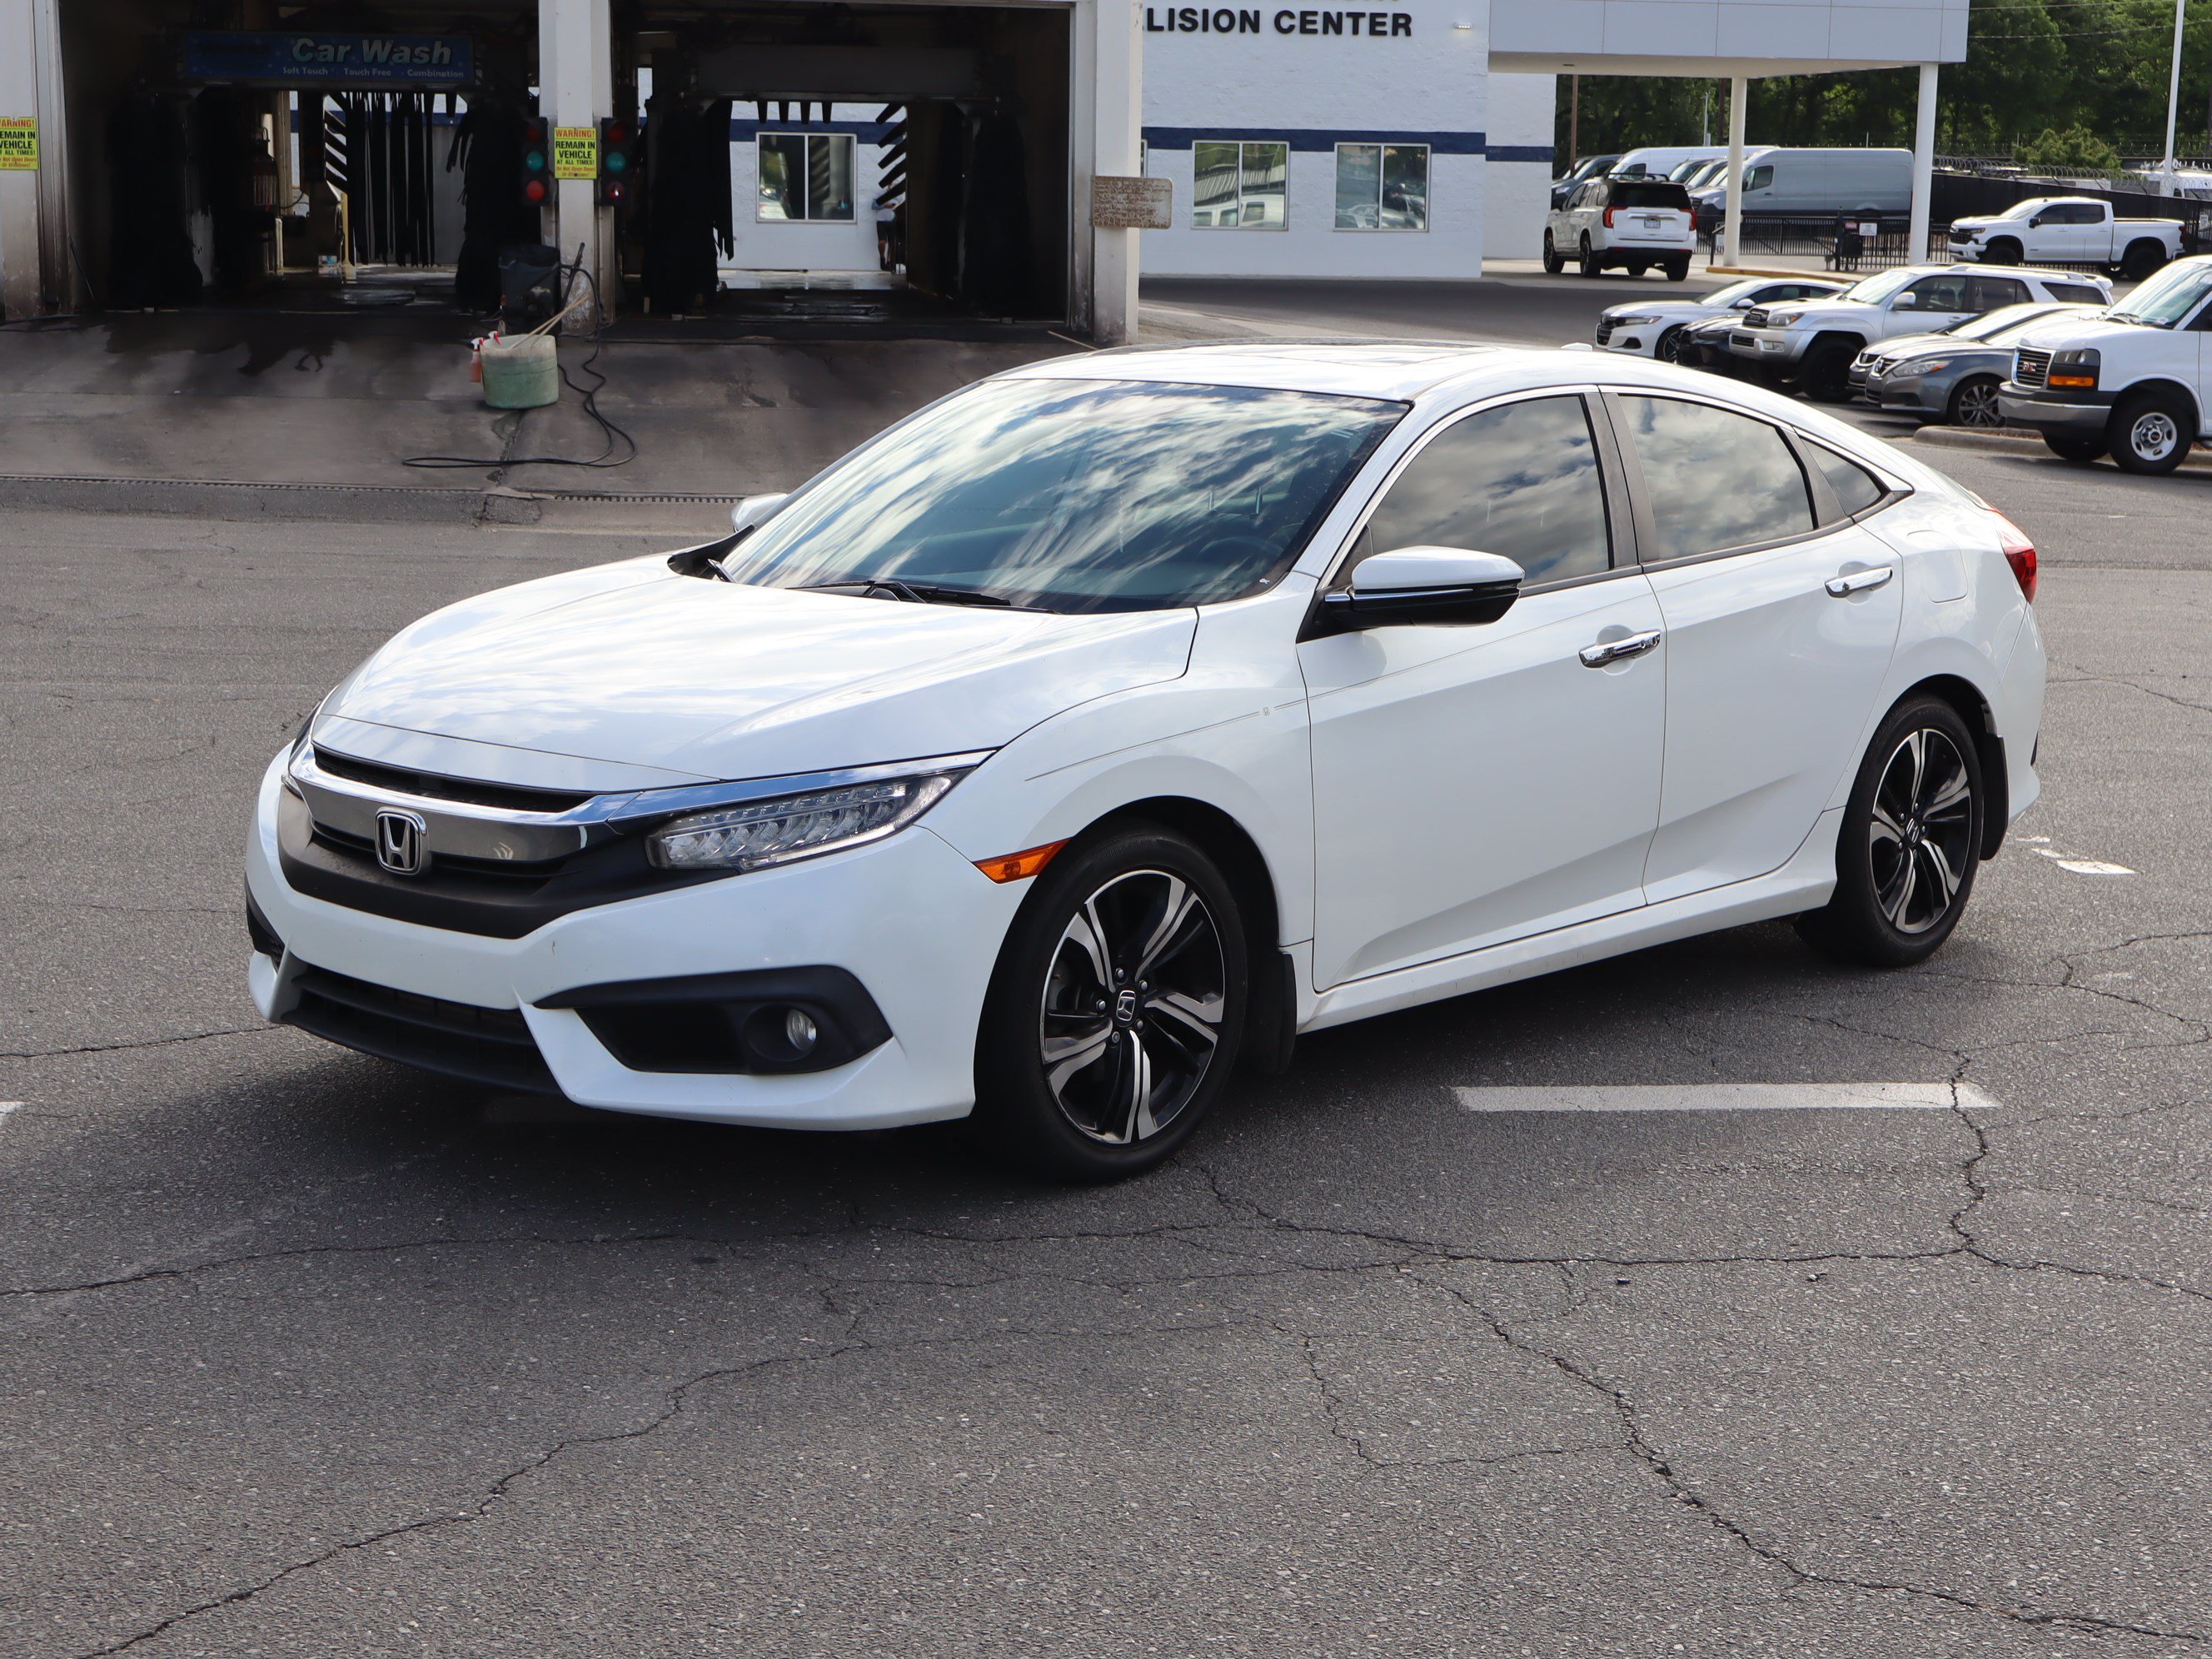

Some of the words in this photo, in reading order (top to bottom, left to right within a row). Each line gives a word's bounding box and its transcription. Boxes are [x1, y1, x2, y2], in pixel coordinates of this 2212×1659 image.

[1147, 7, 1260, 33] LISION
[1273, 10, 1412, 37] CENTER
[292, 37, 352, 63] Car
[361, 39, 452, 65] Wash
[282, 66, 300, 75] Soft
[302, 66, 328, 76] Touch
[344, 67, 370, 76] Touch
[372, 67, 391, 77] Free
[406, 68, 464, 78] Combination
[0, 119, 35, 127] ARNING!
[27, 131, 36, 139] IN
[555, 129, 595, 137] WARNING!
[555, 141, 585, 149] REMAIN
[587, 141, 595, 149] IN
[559, 150, 592, 158] VEHICLE
